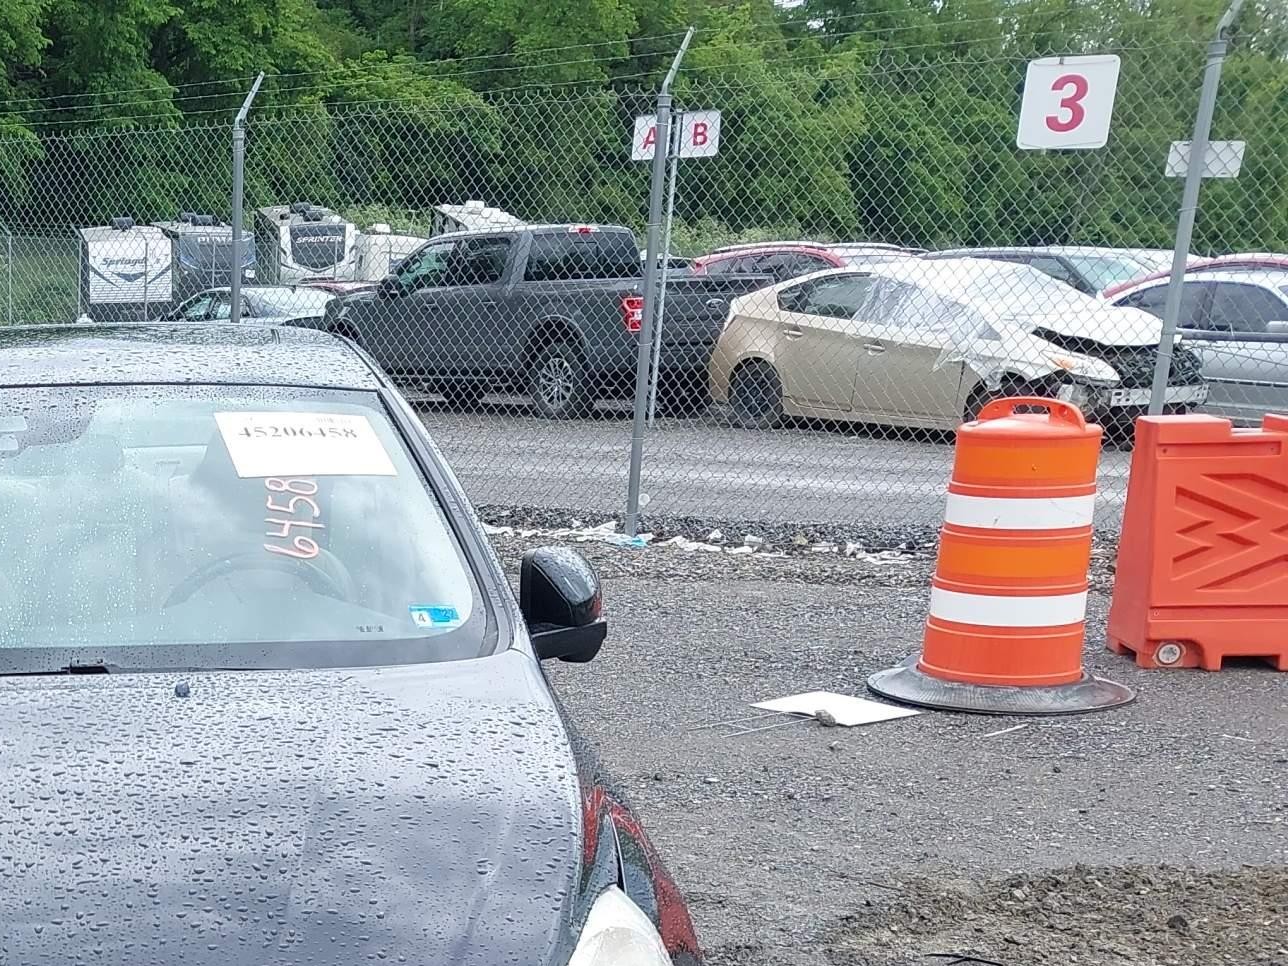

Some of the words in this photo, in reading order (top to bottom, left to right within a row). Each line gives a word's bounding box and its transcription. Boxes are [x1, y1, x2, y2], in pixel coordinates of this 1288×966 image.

[1045, 74, 1089, 132] 3
[692, 122, 708, 146] B
[296, 235, 344, 244] SPRINTER
[263, 477, 326, 559] 6458
